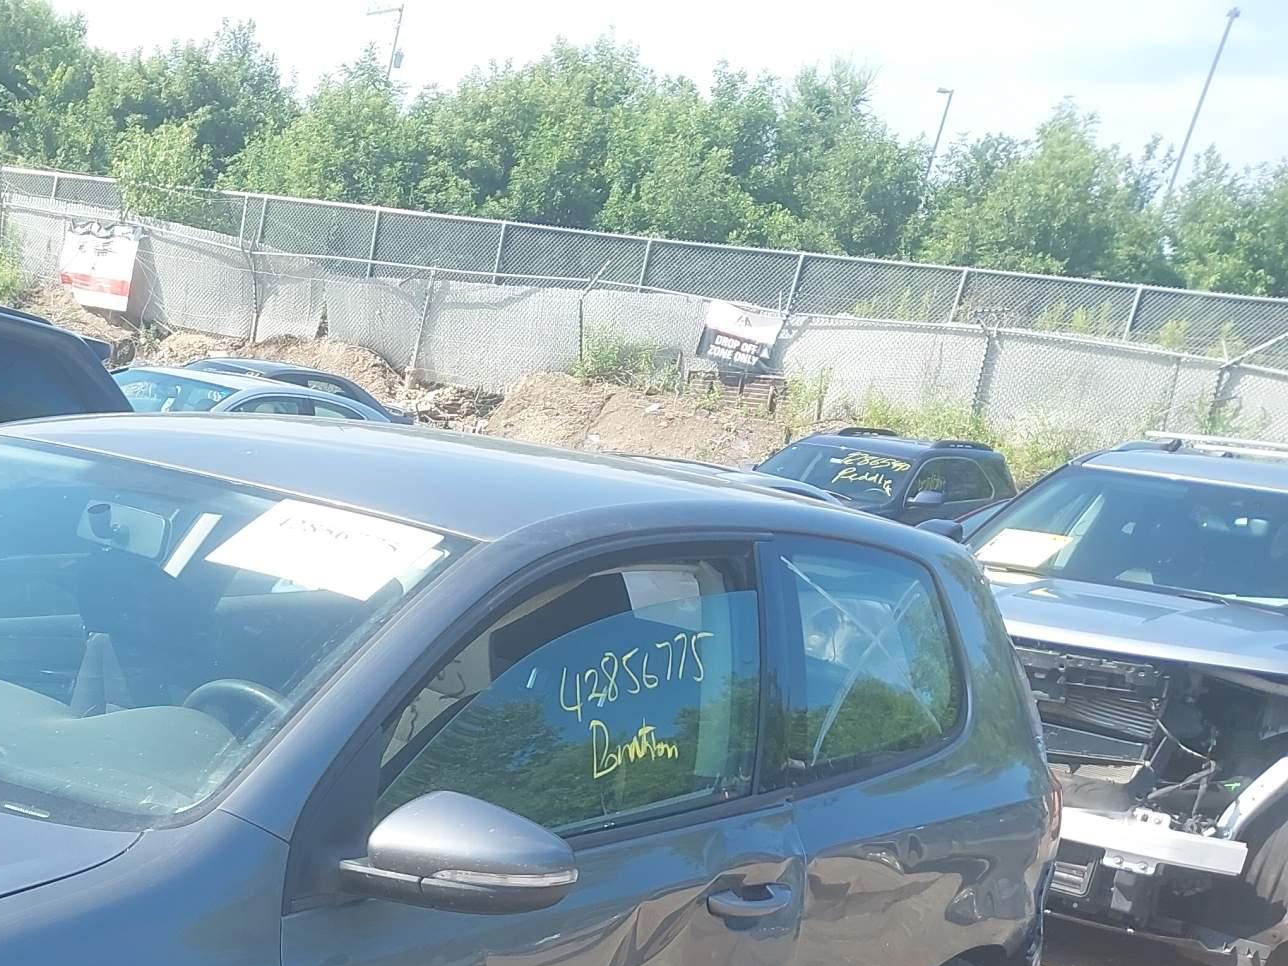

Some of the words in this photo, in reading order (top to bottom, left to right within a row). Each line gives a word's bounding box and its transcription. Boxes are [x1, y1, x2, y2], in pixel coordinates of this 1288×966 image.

[707, 344, 734, 360] ZONE
[733, 351, 759, 366] ONLY
[715, 335, 741, 350] DROP
[741, 342, 759, 355] OFF
[560, 632, 715, 722] 42856775
